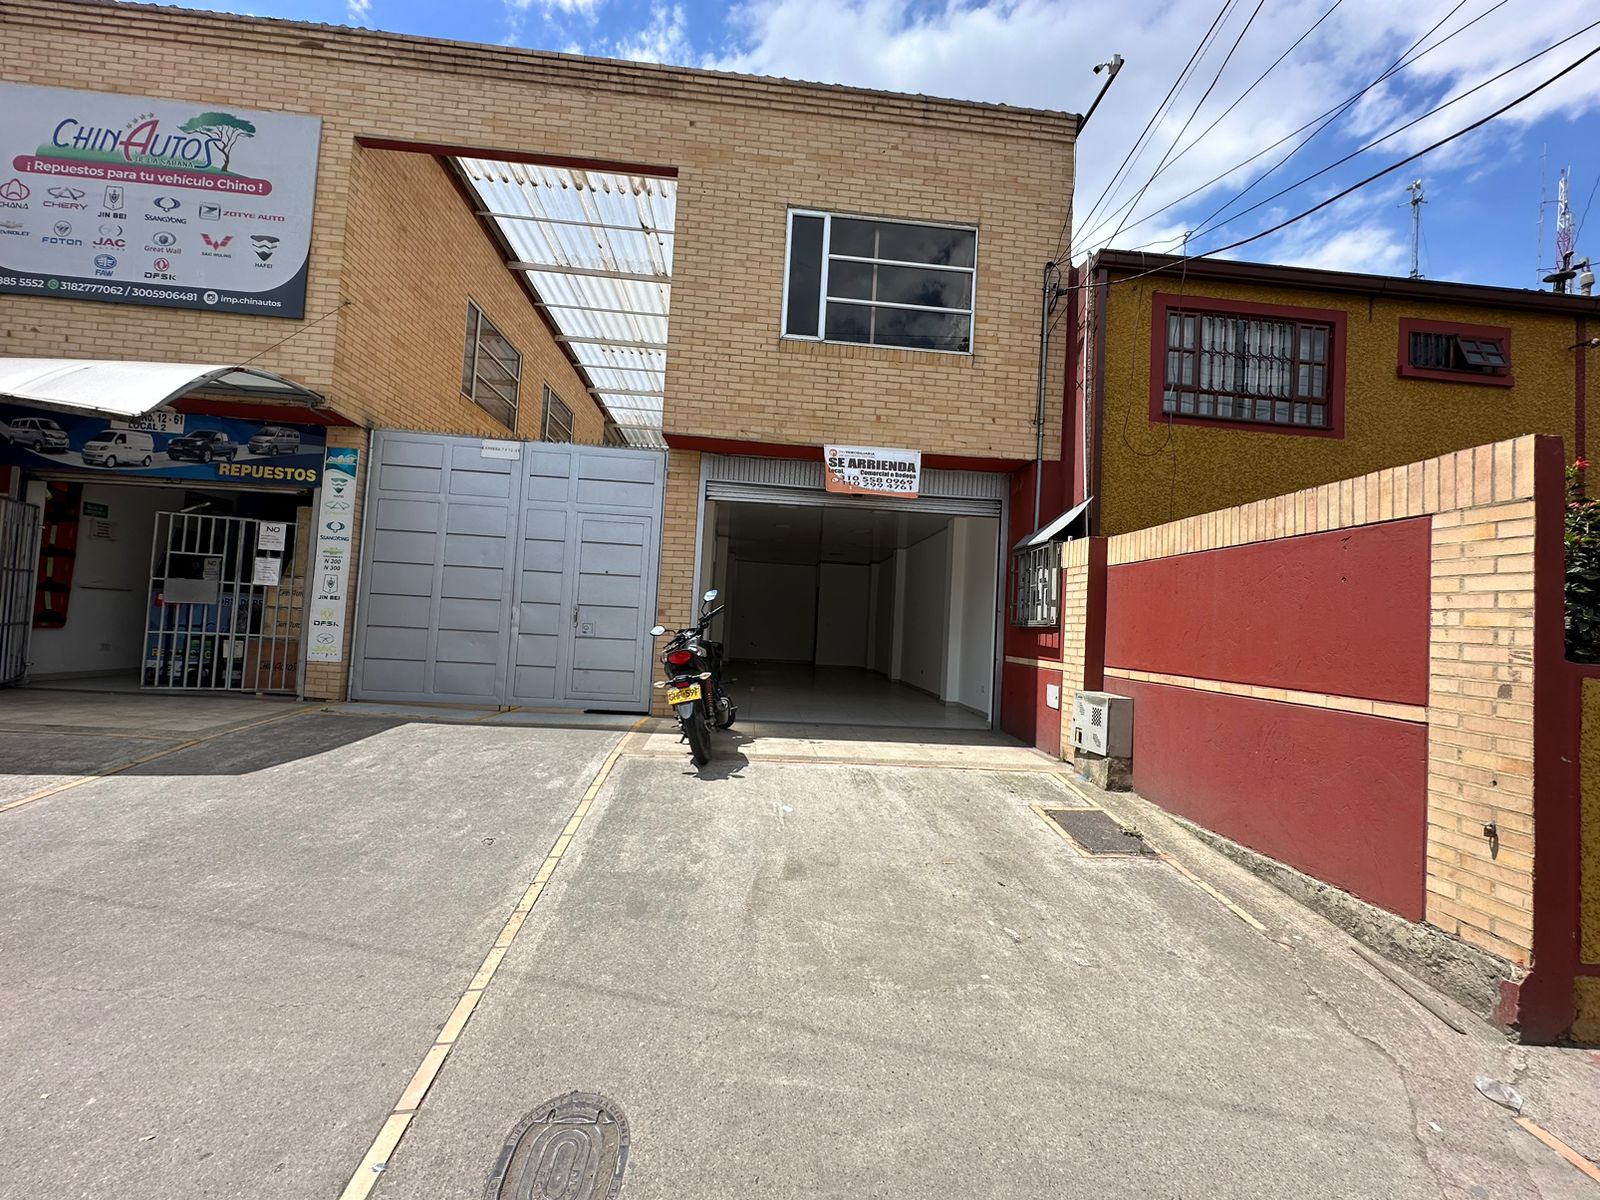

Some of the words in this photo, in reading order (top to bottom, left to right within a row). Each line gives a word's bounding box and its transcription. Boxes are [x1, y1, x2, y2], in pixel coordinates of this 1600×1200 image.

[34, 160, 104, 177] Repuestos
[107, 169, 136, 182] para
[140, 171, 154, 181] tu
[158, 174, 214, 188] vehículo
[217, 179, 256, 192] Chino
[43, 200, 88, 210] CHERY
[97, 211, 111, 219] JIN
[112, 212, 127, 220] BEI
[144, 213, 187, 224] SSANGYONG
[223, 210, 256, 219] ZOTYE
[258, 214, 285, 222] AUTO
[41, 236, 82, 246] FOTON
[92, 237, 126, 248] JAC
[143, 245, 165, 253] Great
[166, 246, 182, 254] Wall
[95, 269, 114, 277] FAW
[144, 271, 177, 281] DFSK
[18, 278, 45, 288] 5552
[60, 281, 123, 295] 3182777062
[132, 287, 198, 301] 3005906481
[220, 293, 282, 308] imp.chinautos
[157, 413, 167, 423] 12
[174, 414, 183, 425] 61
[128, 422, 158, 431] LOCAL
[828, 457, 845, 468] SE
[847, 458, 916, 473] ARRIENDA
[218, 462, 317, 483] REPUESTOS
[828, 467, 844, 475] Local
[266, 525, 281, 533] NO
[312, 645, 337, 653] JAC
